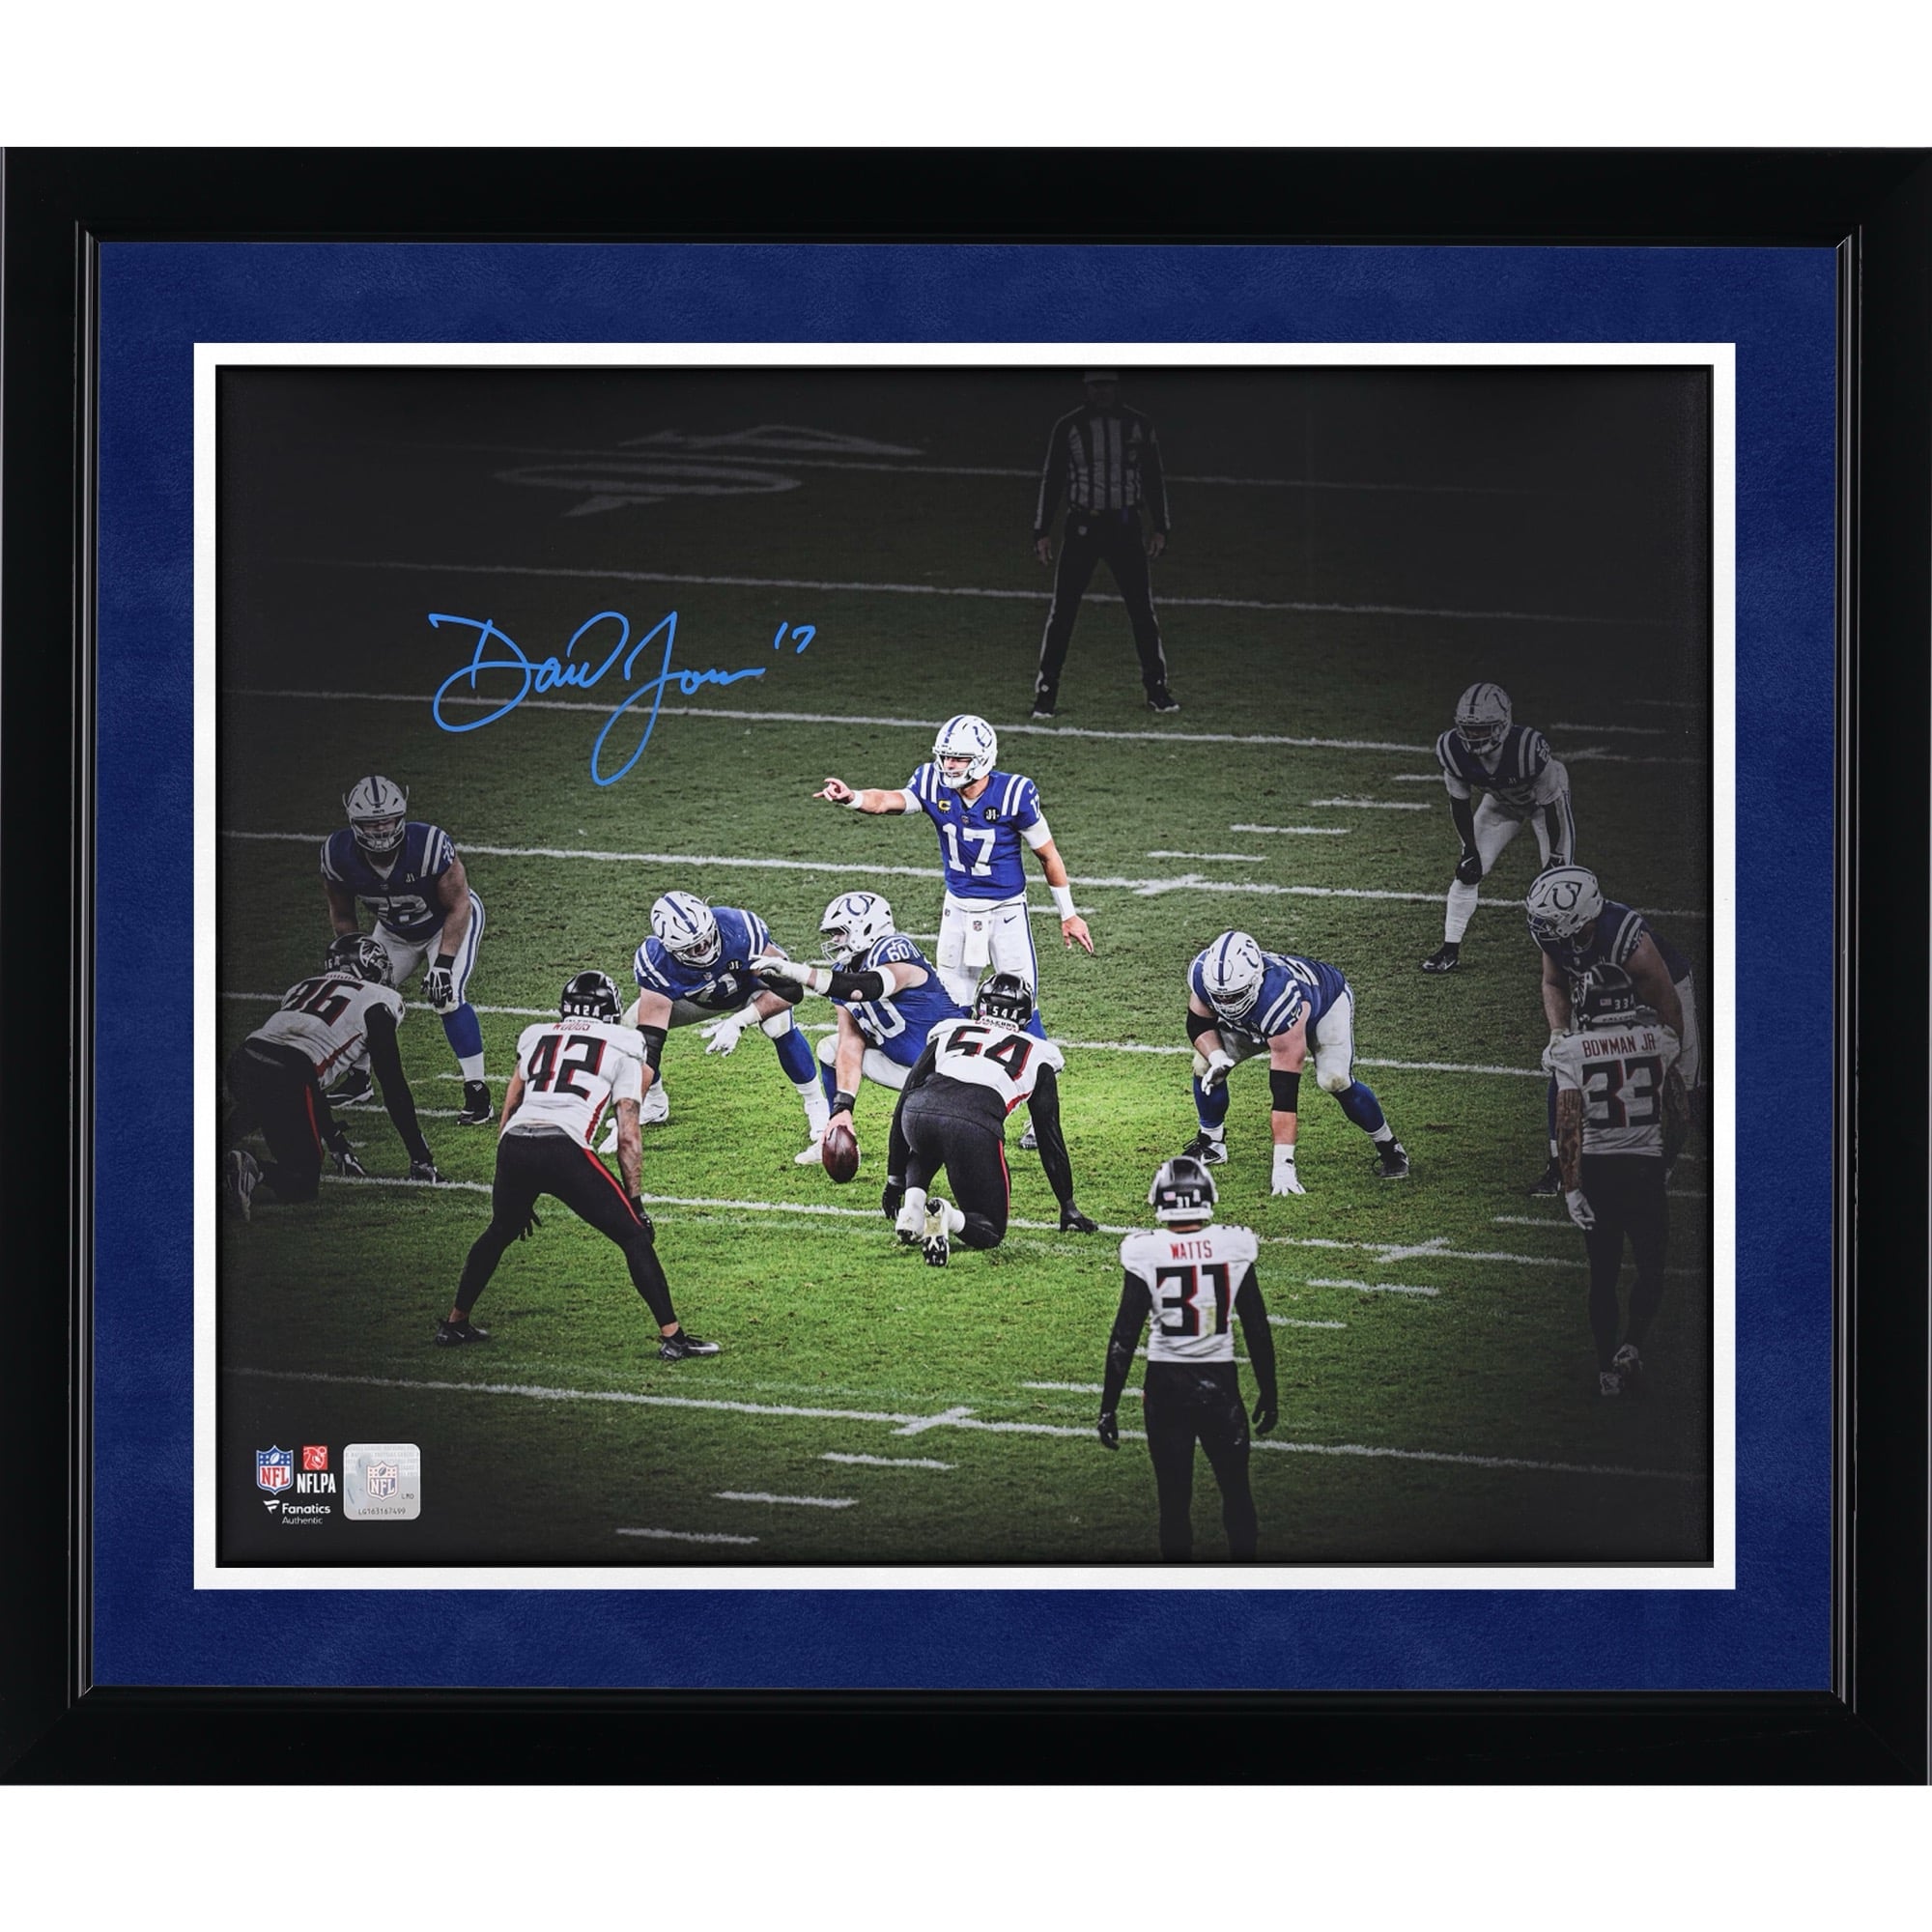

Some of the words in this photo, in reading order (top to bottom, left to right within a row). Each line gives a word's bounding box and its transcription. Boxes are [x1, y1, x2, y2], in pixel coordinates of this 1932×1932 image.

[773, 621, 816, 654] 17
[942, 822, 996, 876] 17
[886, 943, 910, 962] 60
[946, 1026, 1034, 1082] 54
[1582, 1036, 1637, 1059] BOWMAN
[1641, 1033, 1657, 1051] JR
[527, 1035, 607, 1101] 42
[1582, 1054, 1662, 1129] 33
[1170, 1239, 1212, 1260] WATTS
[1155, 1262, 1231, 1336] 31
[262, 1466, 289, 1486] NFL
[297, 1473, 336, 1493] NFLPA
[370, 1478, 395, 1496] NFL
[282, 1503, 330, 1514] Fanatics
